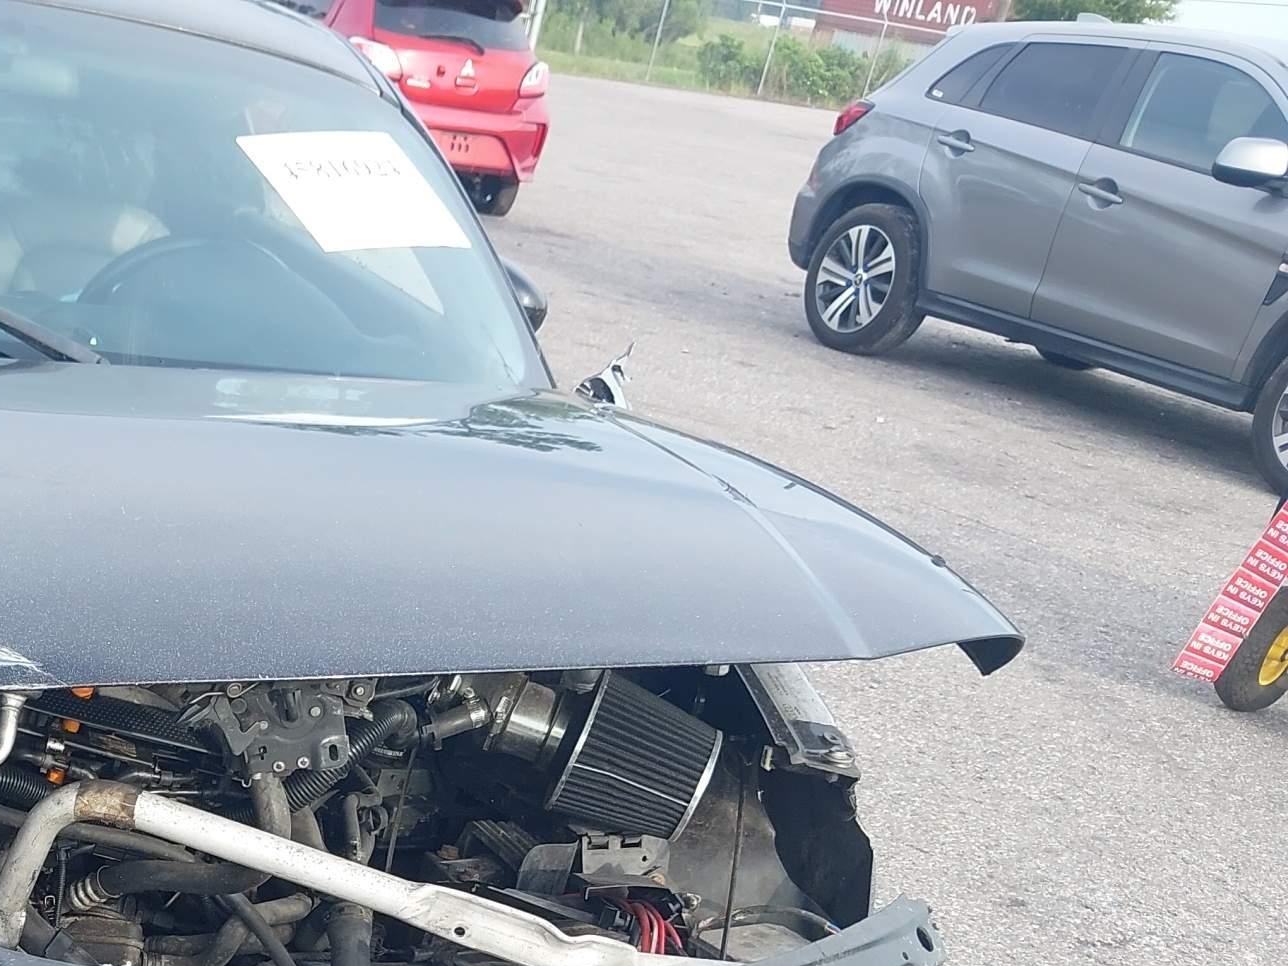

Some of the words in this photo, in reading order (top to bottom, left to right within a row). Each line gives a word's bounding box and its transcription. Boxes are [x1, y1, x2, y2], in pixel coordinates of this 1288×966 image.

[874, 0, 976, 25] WINLAND
[1246, 556, 1258, 567] IN
[1254, 549, 1288, 571] OFFICE
[1258, 563, 1284, 581] KEYS
[1226, 584, 1238, 595] IN
[1234, 577, 1268, 599] OFFICE
[1239, 591, 1264, 608] KEYS
[1207, 612, 1220, 623] IN
[1216, 605, 1250, 625] OFFICE
[1220, 618, 1246, 633] KEYS
[1189, 640, 1202, 651] IN
[1197, 632, 1232, 652] OFFICE
[1202, 645, 1229, 661] KEYS
[1180, 660, 1214, 678] OFFICE
